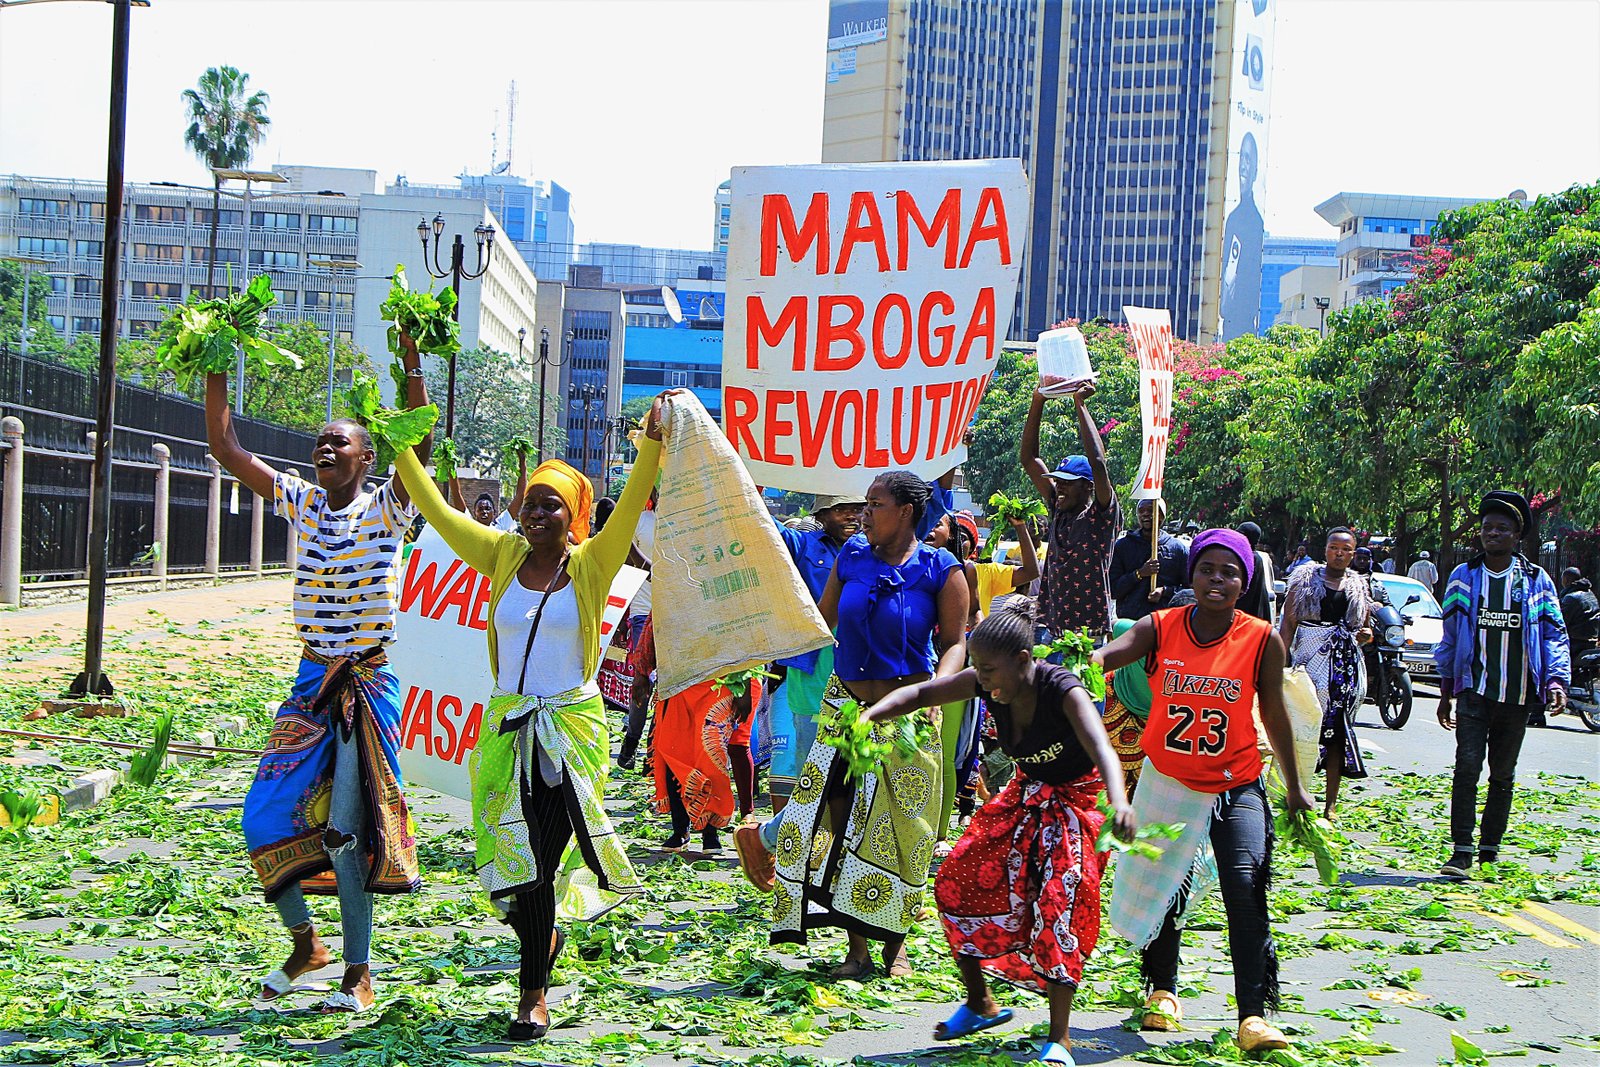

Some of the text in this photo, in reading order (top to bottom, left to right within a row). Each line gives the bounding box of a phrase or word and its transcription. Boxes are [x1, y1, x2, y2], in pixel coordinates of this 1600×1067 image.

[843, 17, 887, 36] WALKER
[1237, 101, 1246, 116] Flip
[1252, 109, 1264, 125] Style
[759, 186, 1013, 276] MAMA
[745, 287, 996, 372] MBOGA
[1150, 379, 1168, 427] BILL
[1480, 608, 1508, 620] Team
[1163, 658, 1185, 667] Sports
[1161, 668, 1242, 703] LAKERS
[1165, 704, 1229, 757] 23
